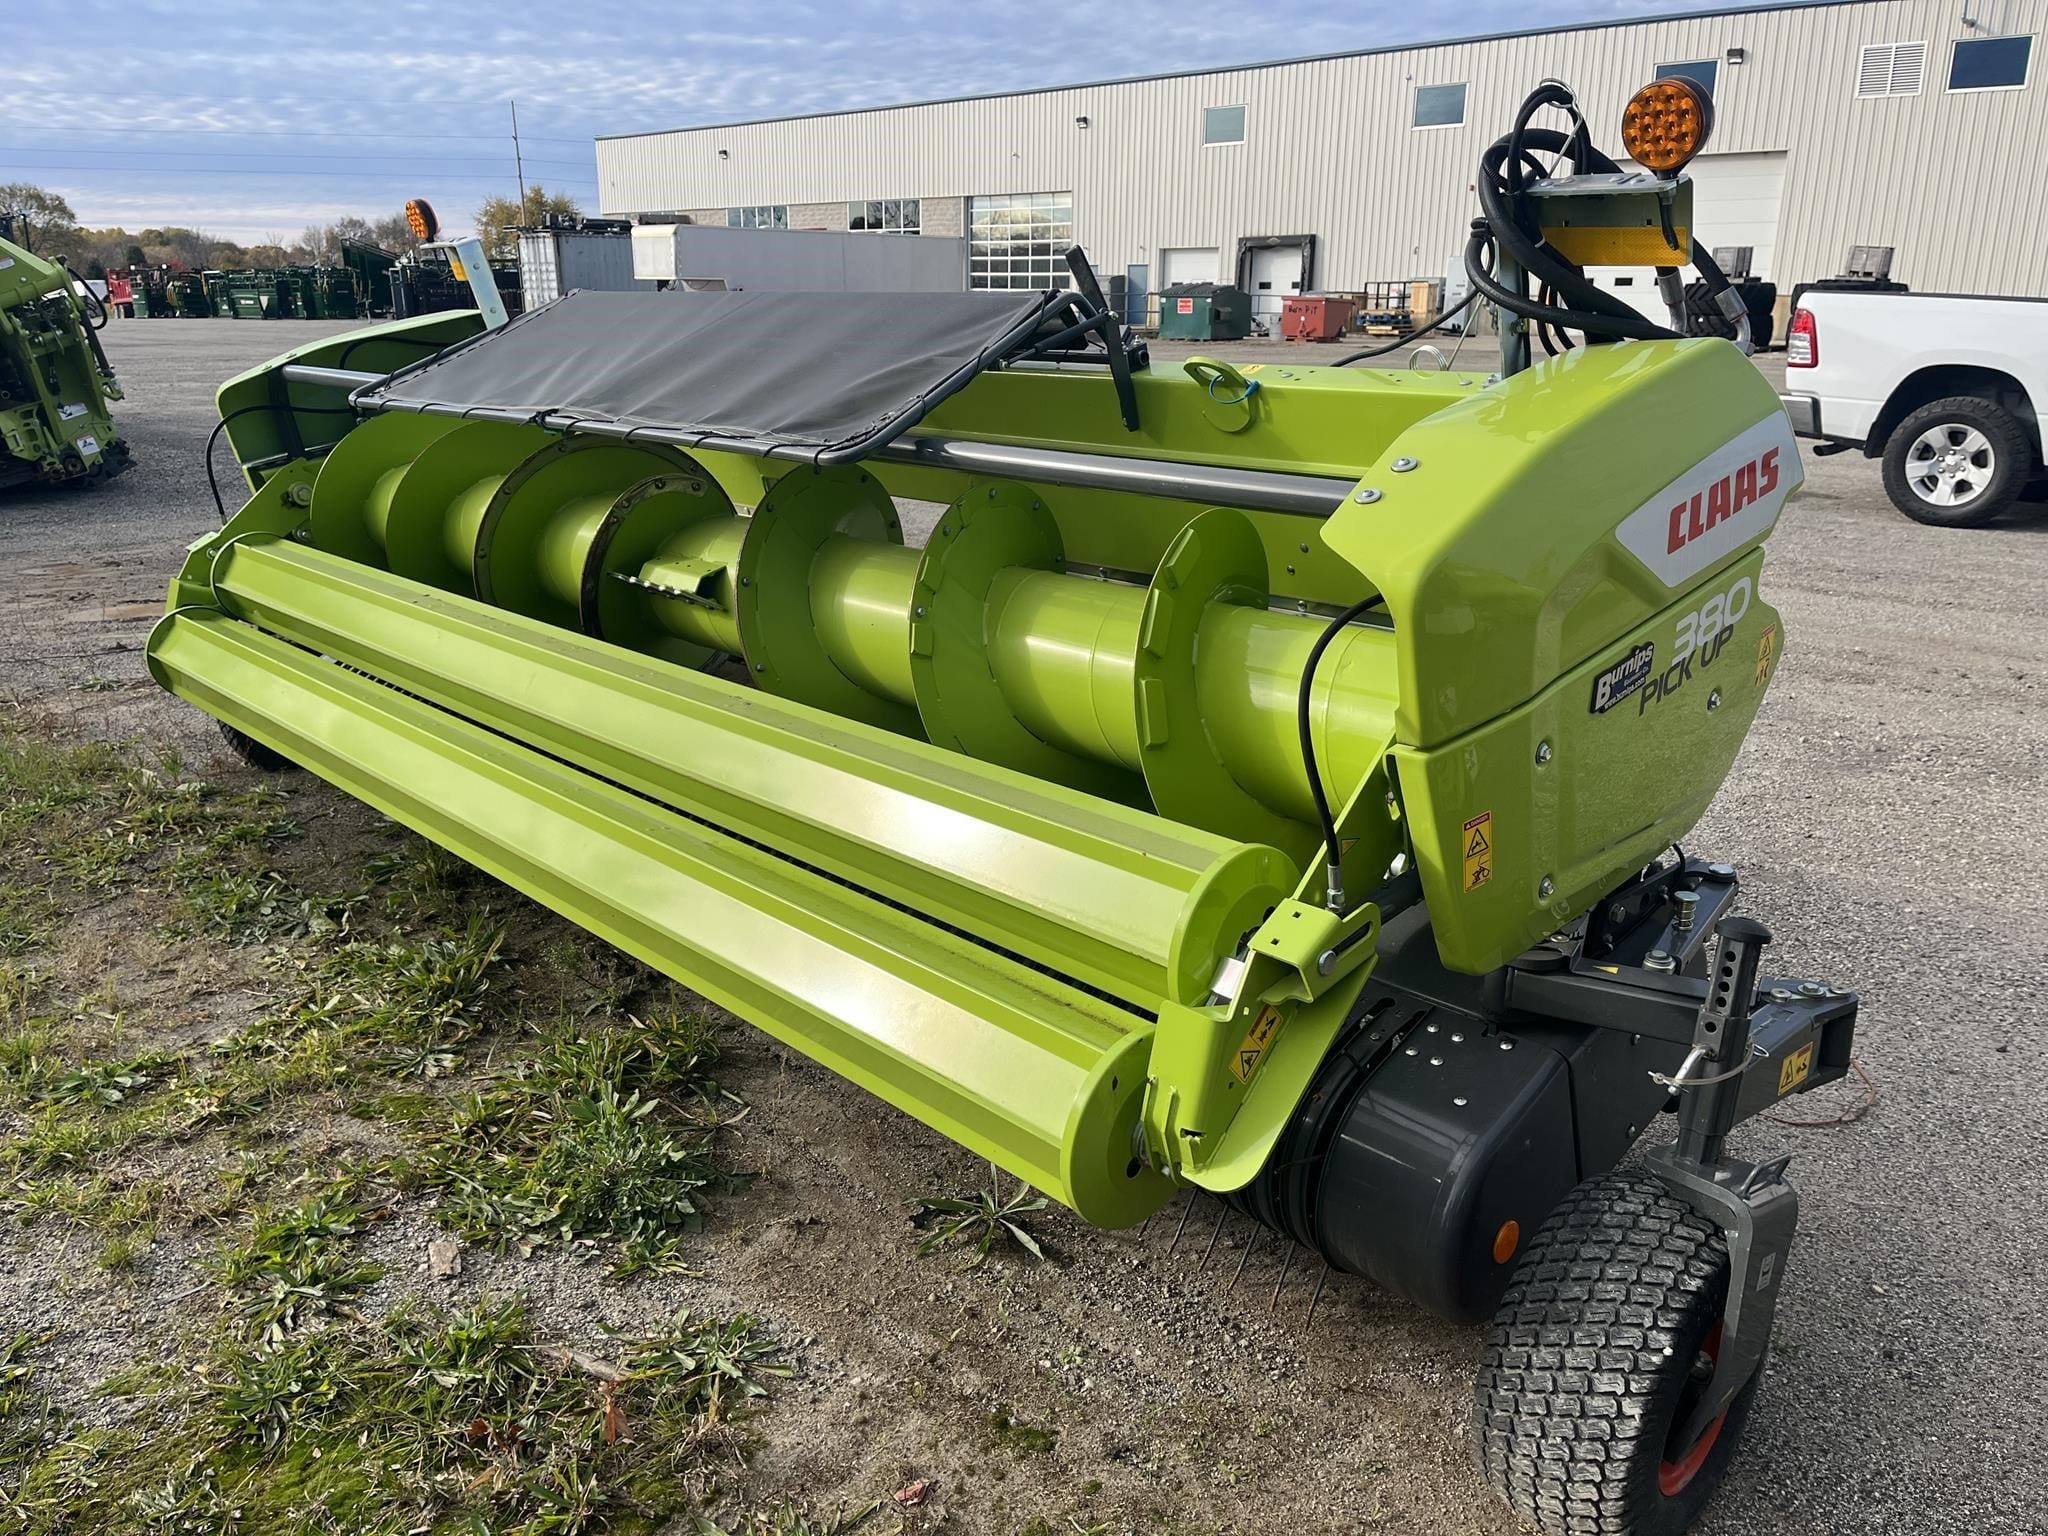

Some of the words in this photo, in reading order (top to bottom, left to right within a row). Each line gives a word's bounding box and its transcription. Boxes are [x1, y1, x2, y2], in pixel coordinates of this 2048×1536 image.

[1666, 446, 1779, 555] CLAAS
[1672, 576, 1751, 667] 380
[1595, 645, 1654, 710] Burnips
[1638, 649, 1697, 717] PICK
[1700, 624, 1734, 668] UP
